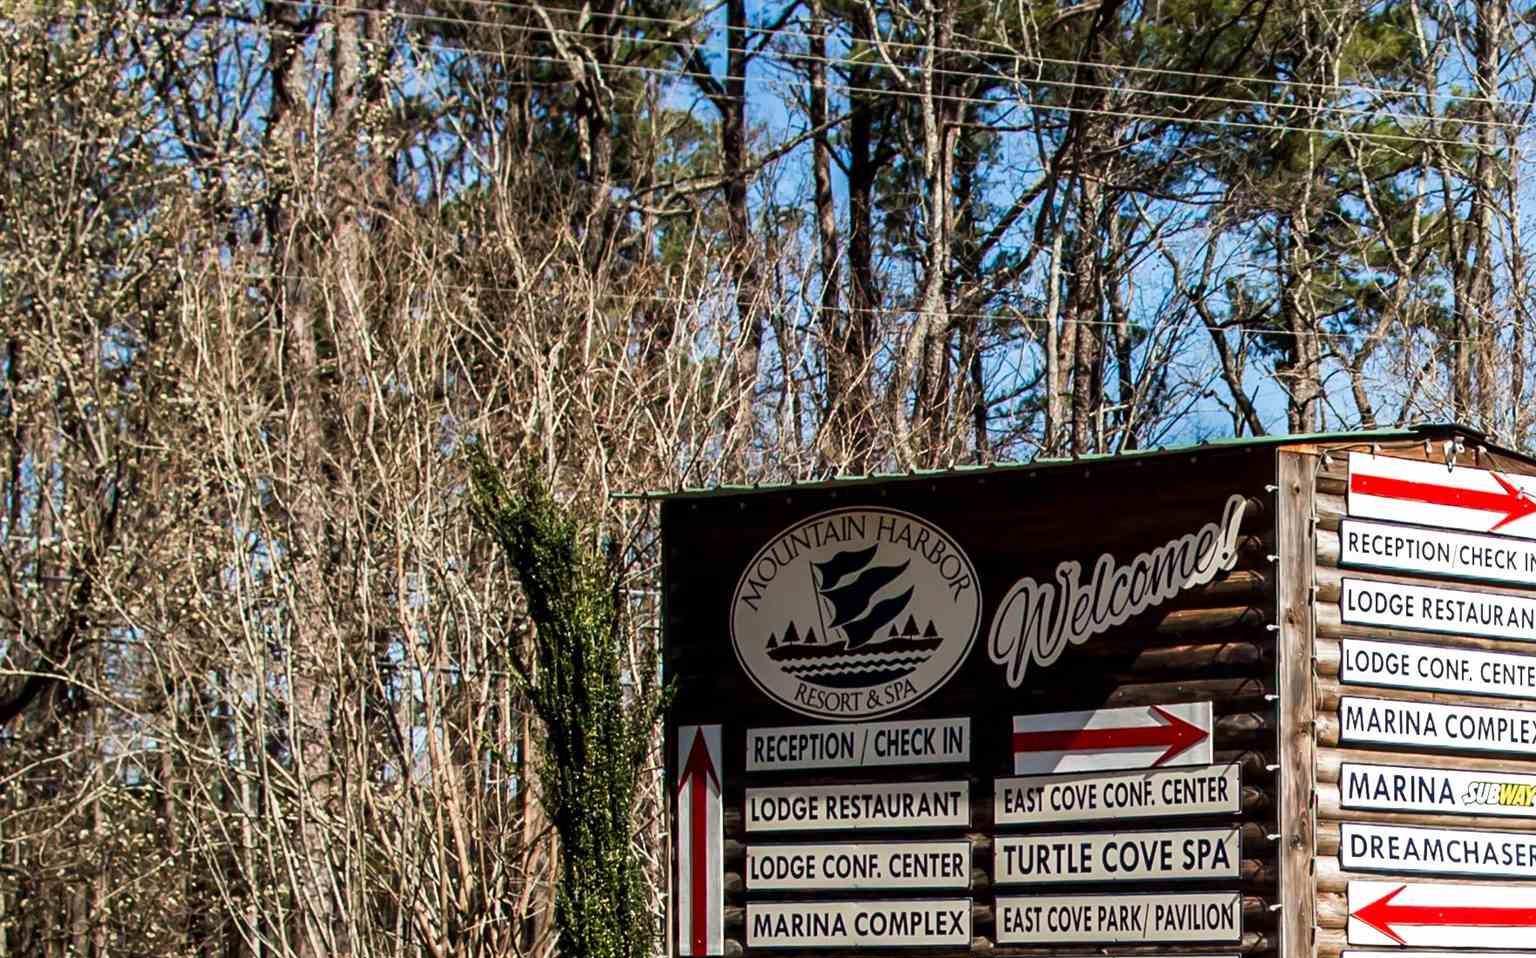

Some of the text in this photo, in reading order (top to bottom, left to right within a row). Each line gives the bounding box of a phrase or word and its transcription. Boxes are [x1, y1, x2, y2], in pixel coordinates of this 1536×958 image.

[741, 515, 970, 612] MOUNTAIN HARBOR
[988, 494, 1247, 688] Welcome!
[1348, 589, 1414, 617] LODGE
[1346, 650, 1410, 676] LODGE
[1417, 657, 1472, 682] CONF.
[794, 679, 917, 712] RESORT & SPA
[1345, 706, 1437, 737] MARINA
[754, 726, 963, 765] RECEPTION / CHECK IN
[1005, 776, 1228, 813] EAST COVE CONF. CENTER
[1349, 772, 1455, 805] MARINA
[751, 792, 961, 821] LODGE RESTAURANT
[751, 853, 963, 880] LODGE CONF. CENTER
[1003, 838, 1229, 875] TURTLE COVE SPA
[753, 911, 964, 937] MARINA COMPLEX
[1004, 907, 1042, 932] EAST
[1048, 906, 1091, 932] COVE
[1156, 903, 1233, 931] PAVILION
